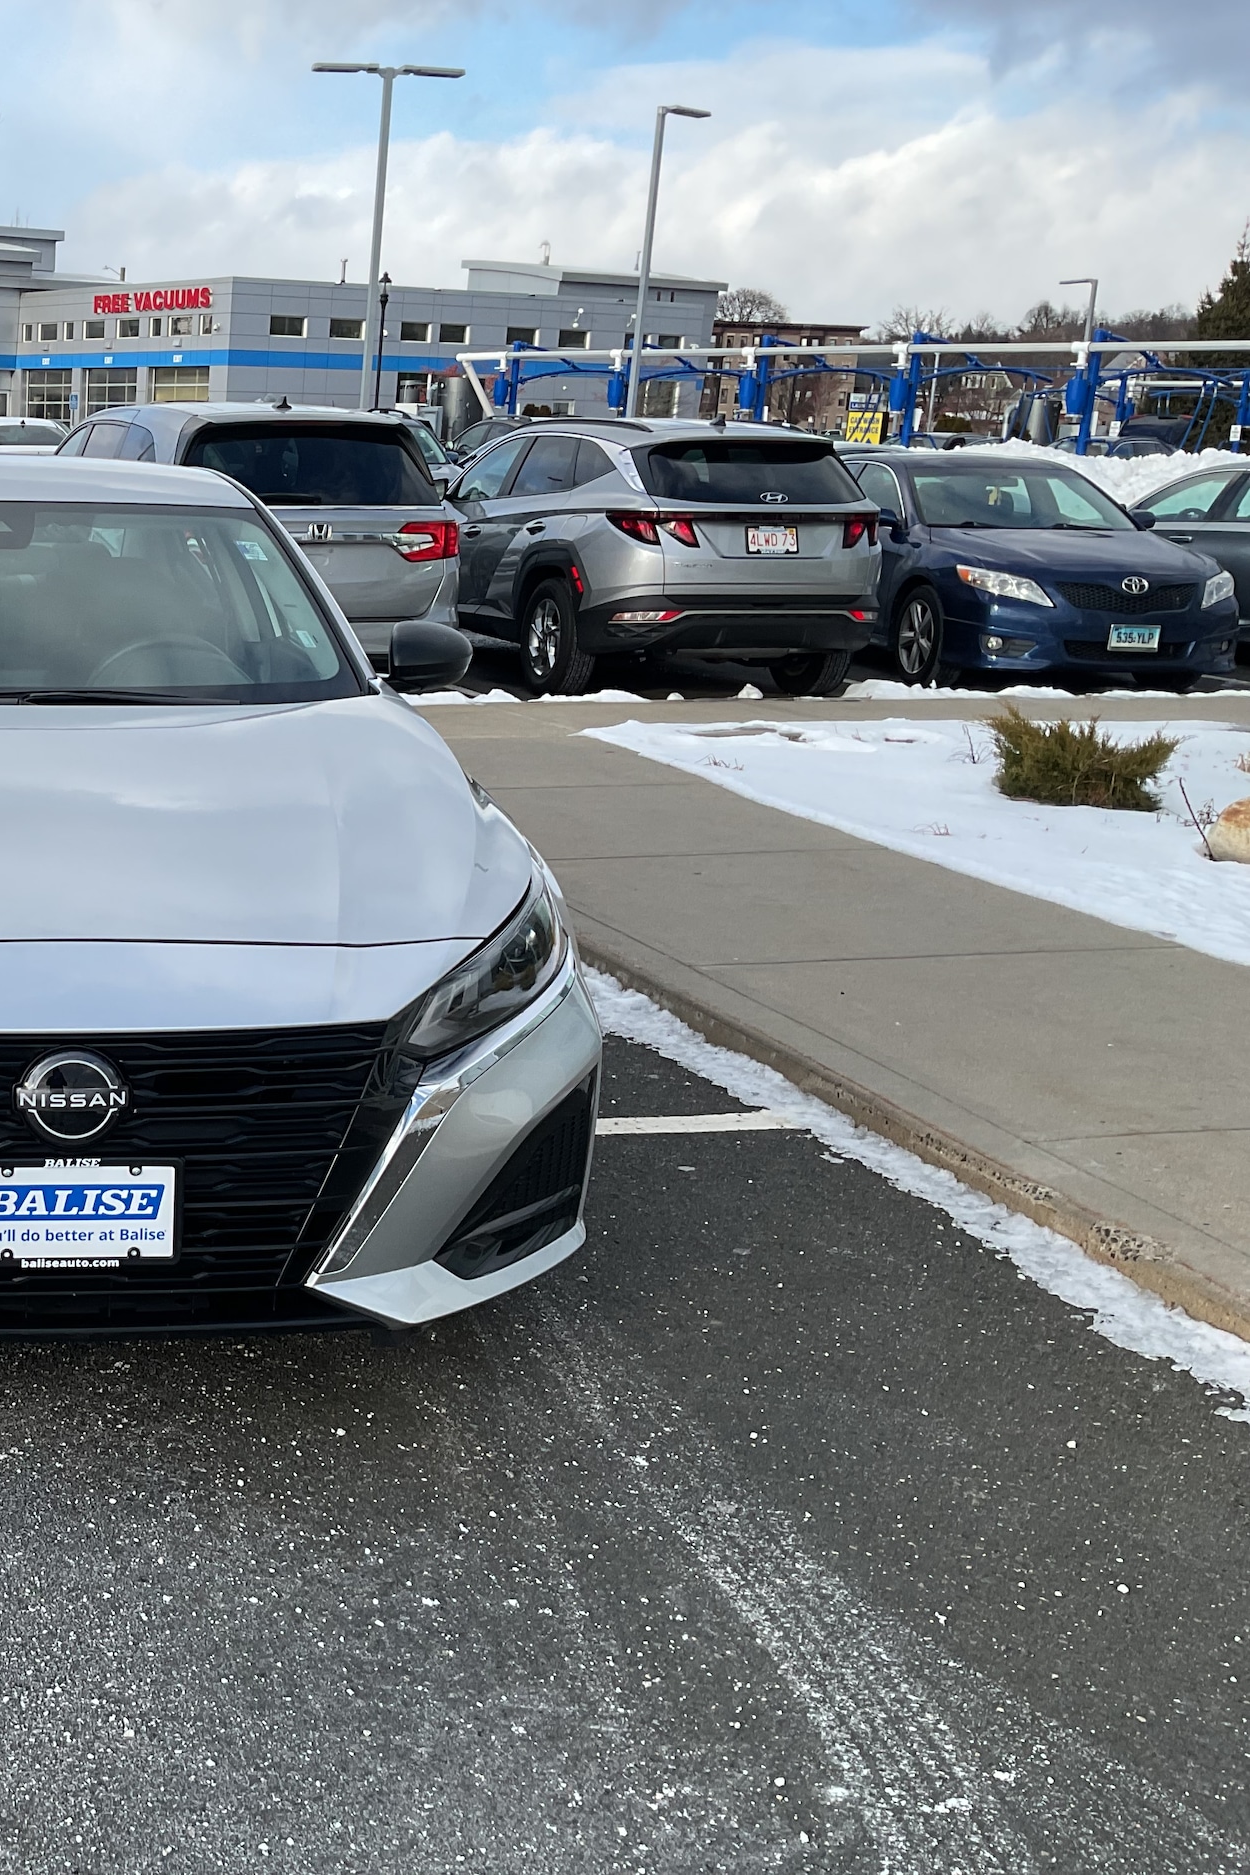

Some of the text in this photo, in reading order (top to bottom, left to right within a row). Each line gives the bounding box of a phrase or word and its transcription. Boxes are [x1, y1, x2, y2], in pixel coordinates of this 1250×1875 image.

[93, 287, 213, 314] FREE VACUUMS
[750, 533, 796, 547] 4LWD 73
[19, 1090, 126, 1108] NISSAN
[43, 1158, 101, 1168] BALISE
[20, 1229, 41, 1242] do
[45, 1229, 94, 1242] better
[99, 1230, 115, 1241] at
[119, 1228, 166, 1241] Balise
[20, 1258, 120, 1269] baliseauto.com
